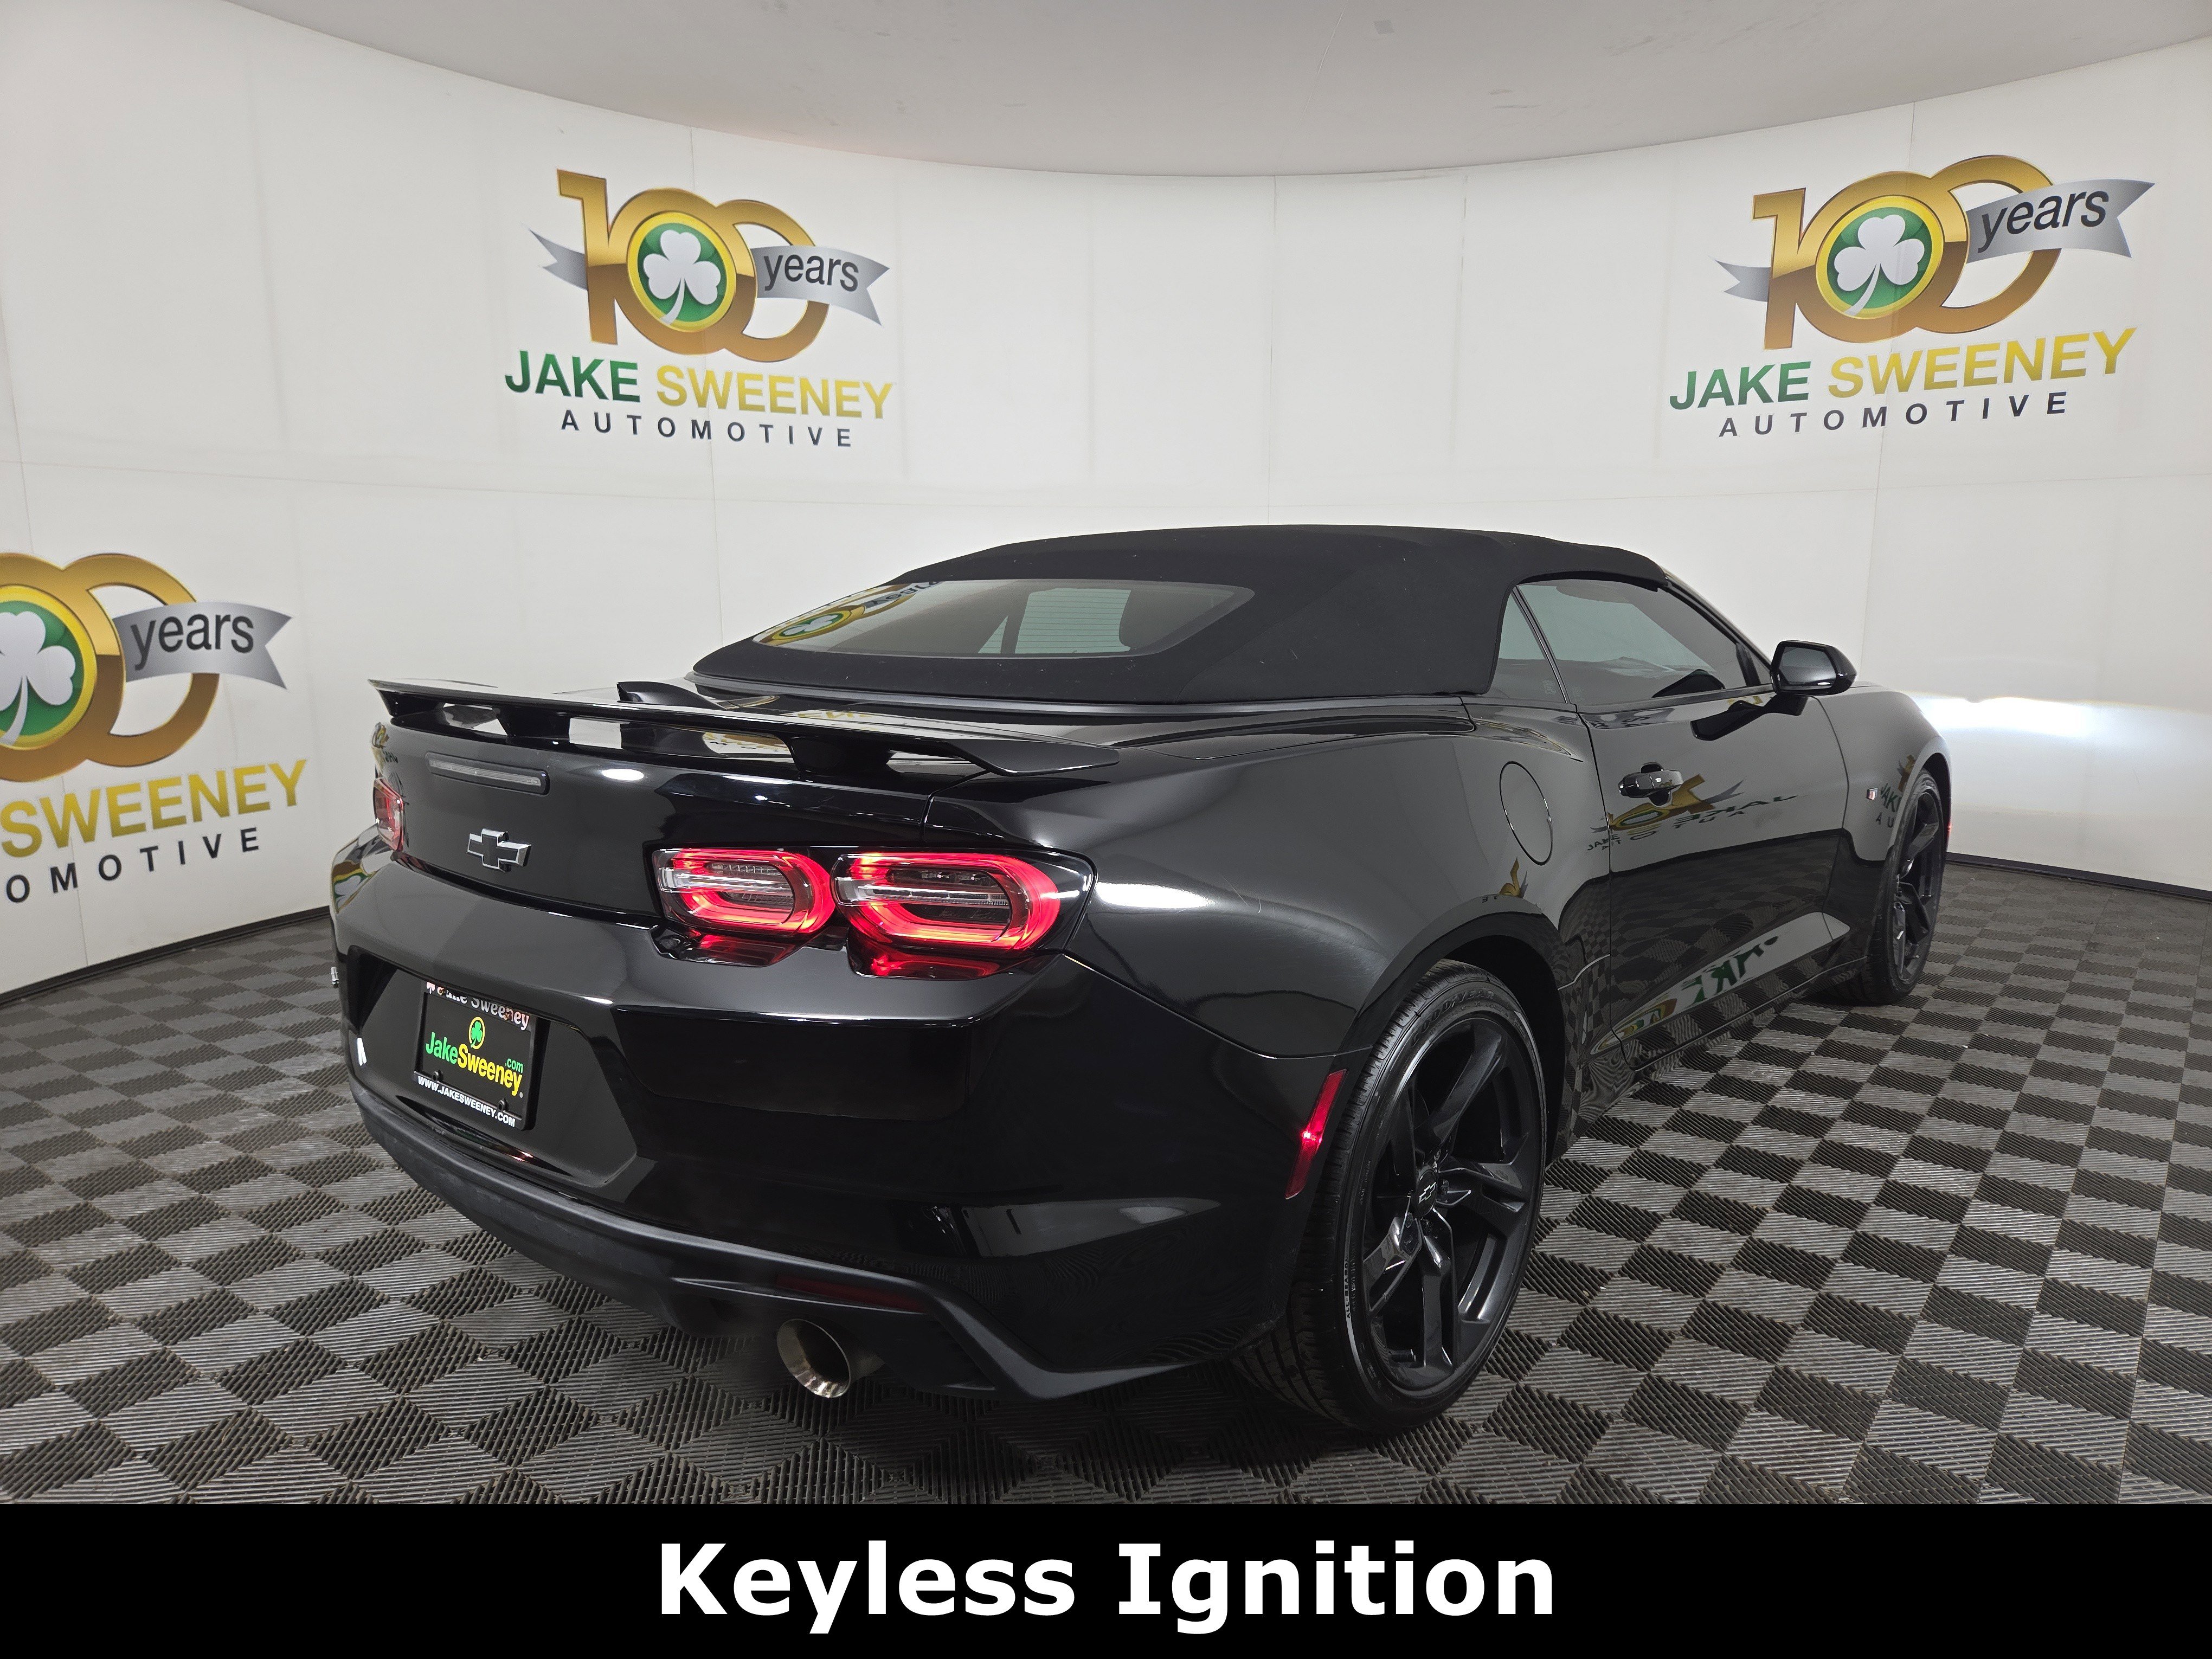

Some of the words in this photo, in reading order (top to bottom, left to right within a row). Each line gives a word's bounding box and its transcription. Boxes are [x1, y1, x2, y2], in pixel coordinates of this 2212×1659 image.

[1753, 155, 2062, 350] 100
[1978, 190, 2109, 253] years
[557, 169, 829, 363] 100
[763, 253, 859, 292] years
[505, 350, 641, 403] JAKE
[657, 365, 893, 419] SWEENEY
[1670, 361, 1811, 410] JAKE
[1828, 327, 2137, 398] SWEENEY
[561, 410, 851, 447] AUTOMOTIVE
[1719, 391, 2067, 438] AUTOMOTIVE
[131, 613, 254, 671] years
[1, 759, 306, 858] SWEENEY
[417, 1076, 516, 1127] WWW.JAKESWEENEY.COM
